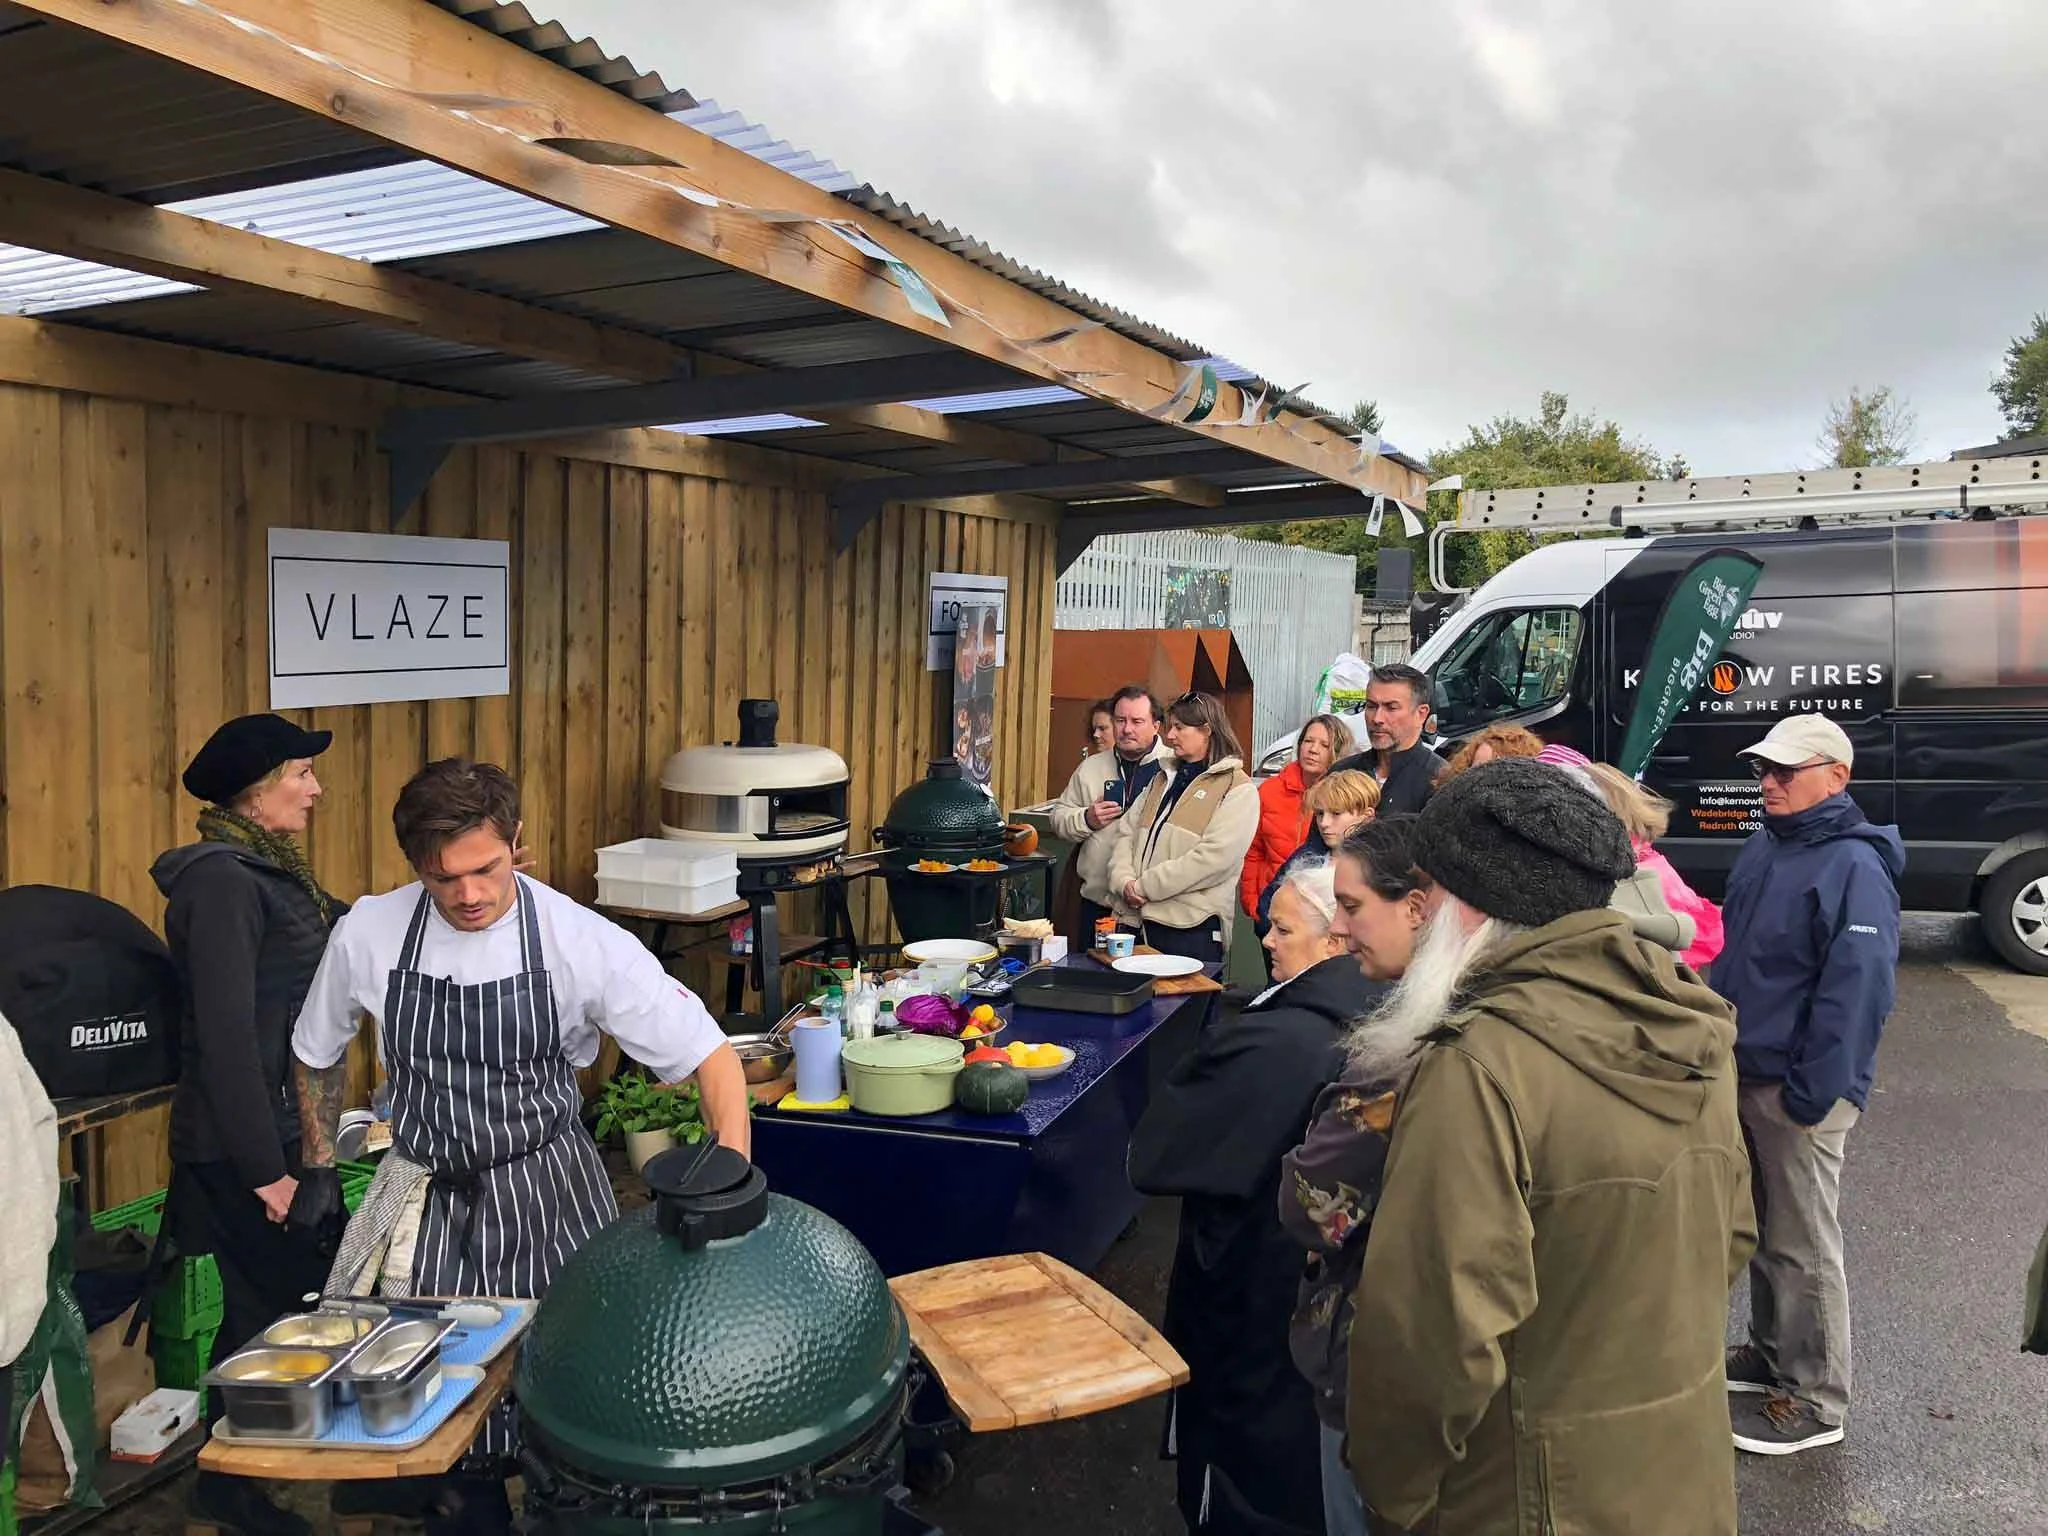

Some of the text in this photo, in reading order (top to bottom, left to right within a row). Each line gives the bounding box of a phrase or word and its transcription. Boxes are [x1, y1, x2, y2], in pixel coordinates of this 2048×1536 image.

[305, 592, 486, 641] VLAZE
[1790, 664, 1883, 686] FIRES
[1700, 700, 1735, 712] FOR
[1744, 700, 1779, 711] THE
[1789, 699, 1863, 710] FUTURE
[1691, 808, 1748, 820] Wadebridge
[1699, 821, 1763, 830] Redruth 0120
